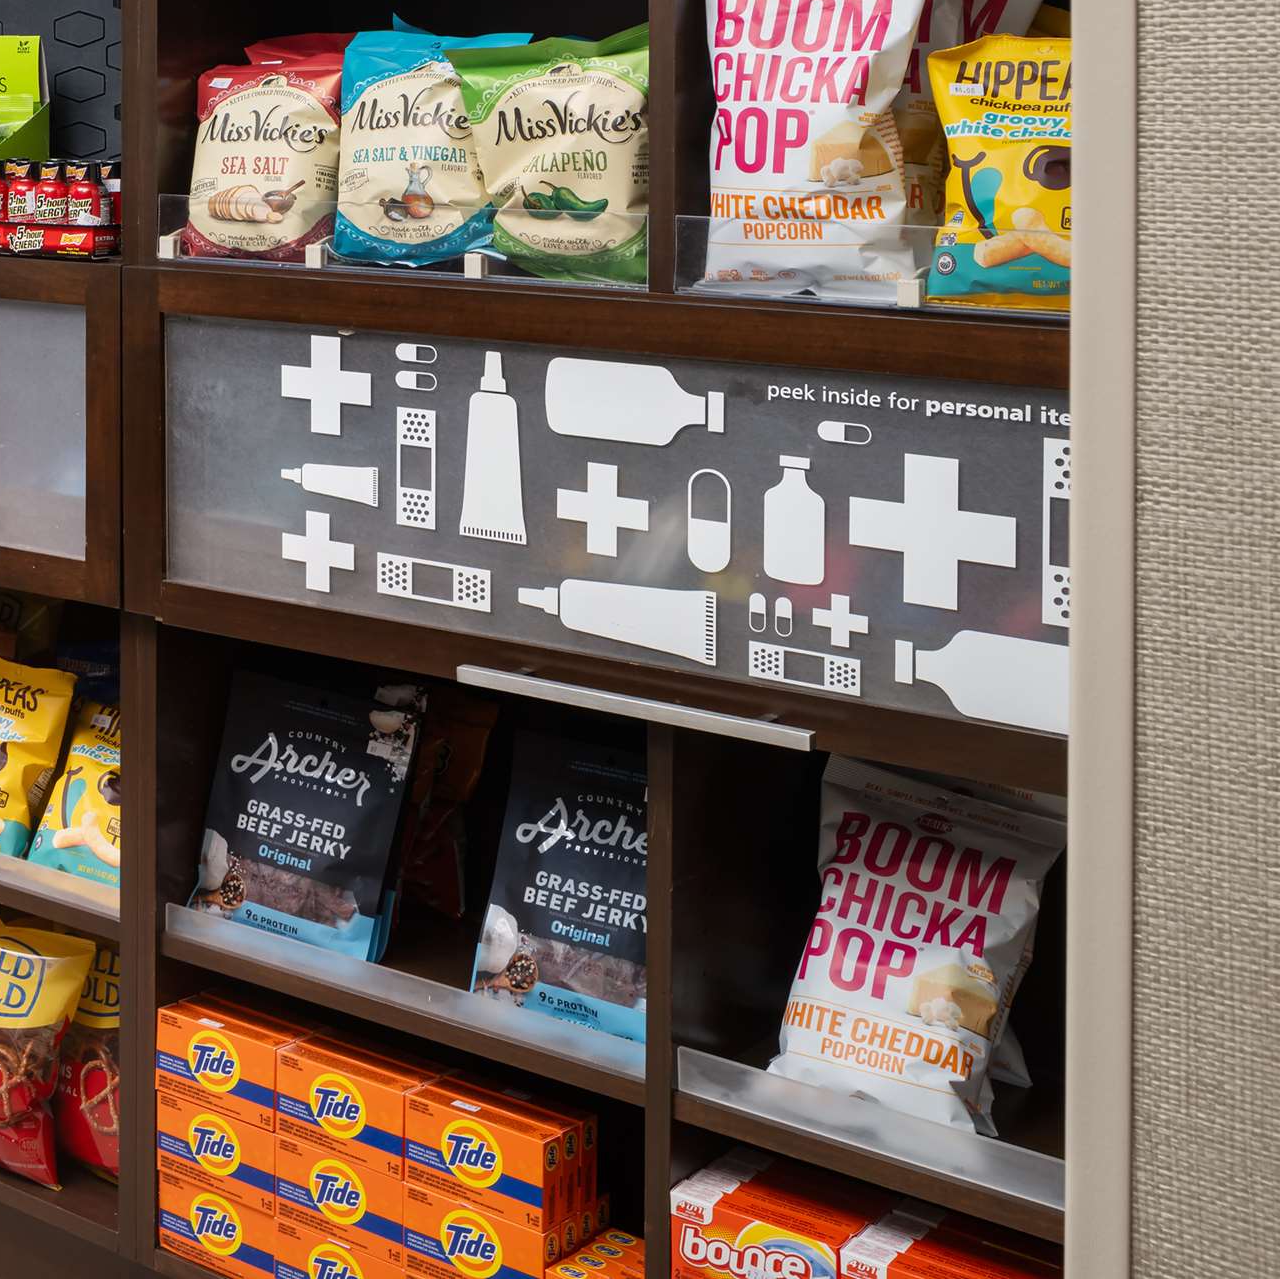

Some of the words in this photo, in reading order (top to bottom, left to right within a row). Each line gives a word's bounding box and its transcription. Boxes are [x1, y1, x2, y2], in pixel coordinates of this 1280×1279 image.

[714, 53, 870, 106] CHICKA
[351, 98, 402, 133] Miss
[970, 96, 1041, 113] chickpea
[946, 122, 1003, 138] white
[984, 111, 1065, 128] groovy
[353, 147, 369, 163] SEA
[372, 147, 397, 163] SALT
[399, 147, 409, 161] &
[412, 145, 467, 163] VINEGAR
[714, 107, 811, 175] POP
[221, 156, 248, 176] SEA
[253, 156, 289, 176] SALT
[763, 193, 885, 220] CHEDDAR
[15, 238, 42, 249] ENERGY
[17, 226, 43, 240] 5-hour
[744, 222, 823, 241] POPCORN
[767, 383, 815, 403] peek
[821, 385, 881, 408] inside
[887, 391, 920, 411] for
[925, 396, 1032, 423] personal
[1040, 404, 1070, 427] ite
[288, 729, 348, 753] COUNTRY
[231, 731, 371, 807] Archer
[274, 773, 348, 800] PROVISIONS
[246, 799, 346, 840] GRASS-FED
[236, 813, 282, 842] BEEF
[285, 827, 351, 861] JERKY
[257, 844, 311, 872] Original
[835, 811, 1017, 916] BOOM
[523, 887, 577, 917] BEEF
[817, 867, 989, 958] CHICKA
[260, 915, 298, 935] PROTEIN
[550, 919, 610, 948] Original
[192, 1042, 235, 1077] Tide
[820, 1037, 906, 1076] POPCORN
[314, 1084, 361, 1123] Tide
